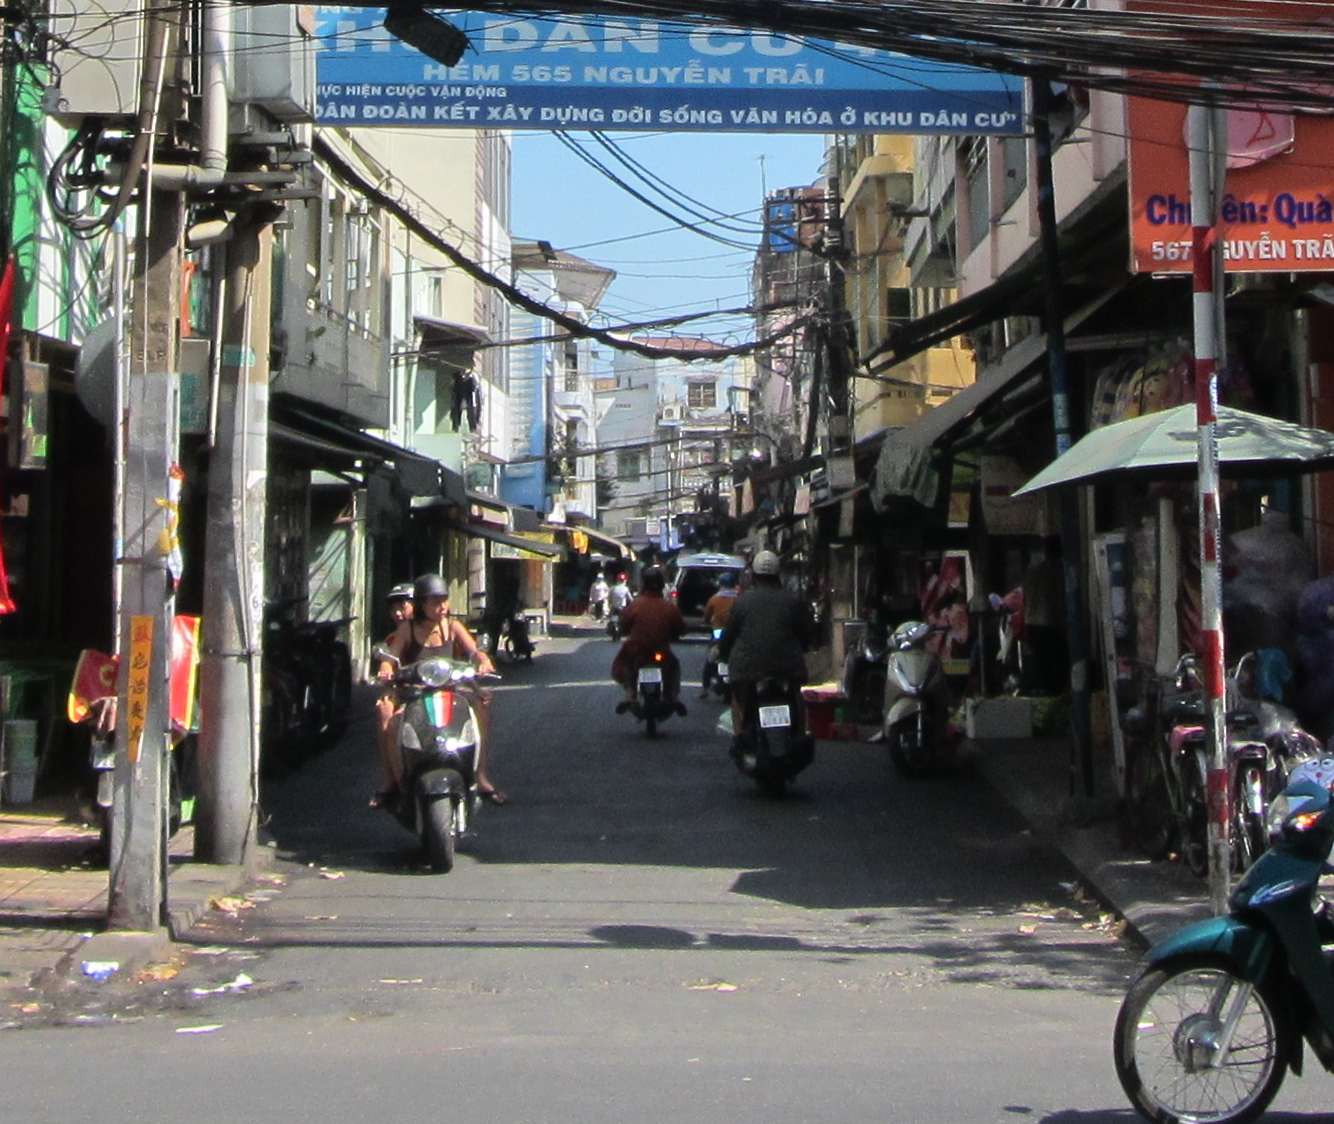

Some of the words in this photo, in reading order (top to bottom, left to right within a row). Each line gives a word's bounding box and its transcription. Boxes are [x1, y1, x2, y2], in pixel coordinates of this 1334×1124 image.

[512, 65, 572, 84] 565
[584, 60, 731, 84] NGUYỄN
[744, 63, 825, 86] TRÃI
[346, 84, 382, 98] HIỆN
[386, 84, 426, 99] CUỘC
[430, 85, 461, 99] VẬN
[465, 86, 507, 100] ĐỘNG
[362, 101, 426, 119] ĐOÀN
[433, 100, 480, 120] KẾT
[487, 103, 534, 121] XÂY
[540, 105, 605, 125] DỰNG
[611, 105, 652, 124] ĐỜI
[658, 104, 723, 124] SỐNG
[730, 107, 778, 124] VĂN
[785, 106, 833, 125] HÓA
[840, 106, 857, 125] Ở
[863, 111, 913, 126] KHU
[919, 109, 967, 126] DÂN
[1146, 193, 1268, 226] Chên:
[1274, 192, 1334, 229] Quà
[1220, 230, 1287, 260] GUYỄN
